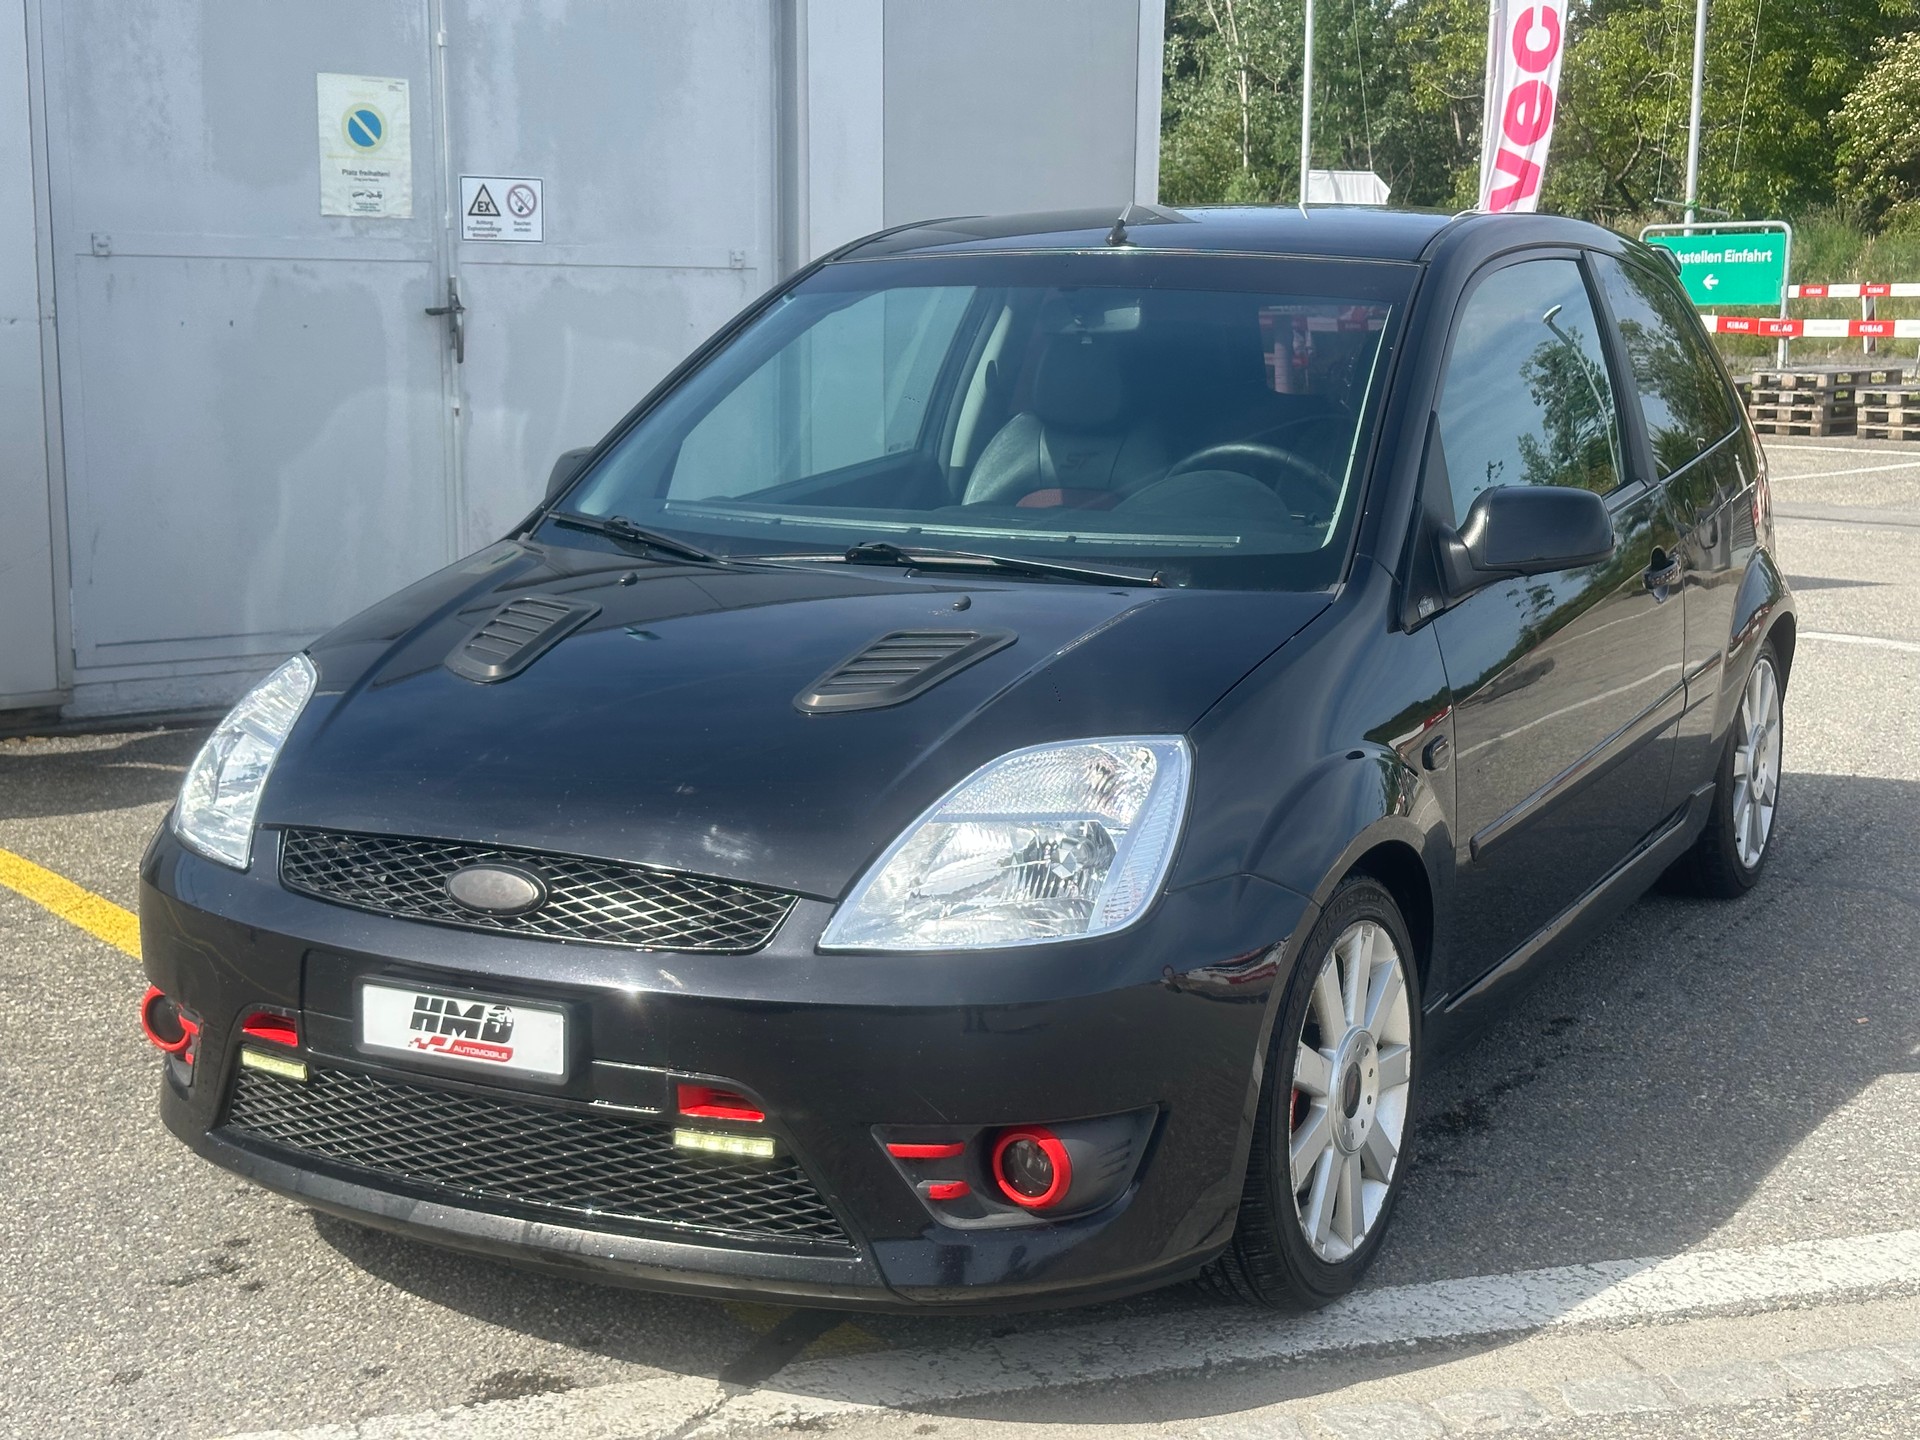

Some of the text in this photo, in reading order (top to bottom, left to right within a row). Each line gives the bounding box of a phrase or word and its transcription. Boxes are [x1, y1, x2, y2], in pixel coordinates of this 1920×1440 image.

[477, 200, 491, 213] EX
[1675, 248, 1772, 264] kstellen Einfahrt
[1805, 287, 1823, 295] KIBAG
[1867, 286, 1884, 294] KIBAG
[1726, 321, 1749, 330] KIBAG
[1769, 324, 1793, 333] KIAG
[1858, 324, 1884, 333] KIBAG
[453, 1045, 509, 1060] AUTOMOBILE
